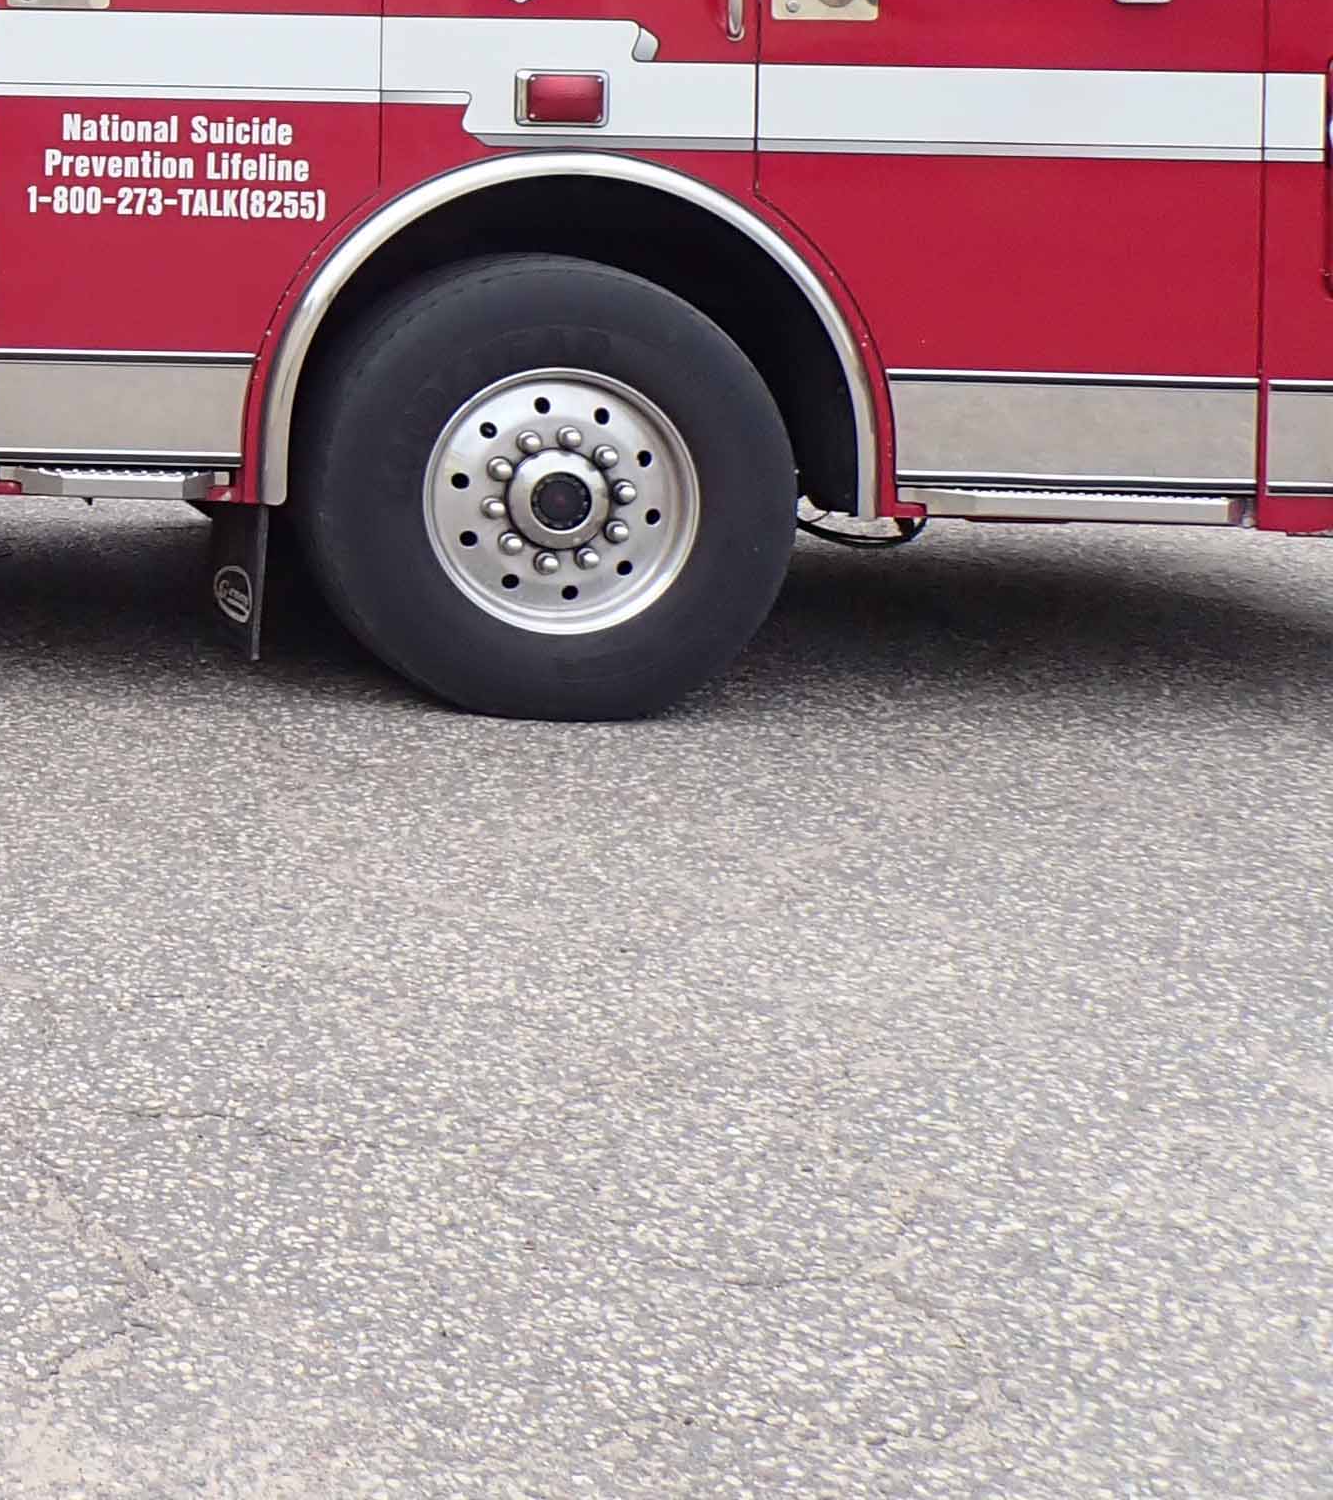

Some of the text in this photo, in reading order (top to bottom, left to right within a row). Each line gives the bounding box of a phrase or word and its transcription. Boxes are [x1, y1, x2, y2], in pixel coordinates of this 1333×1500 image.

[62, 113, 293, 146] National Suicide
[44, 148, 310, 182] Prevention Lifeline
[27, 185, 326, 222] 1-800-273-TALK(8255)
